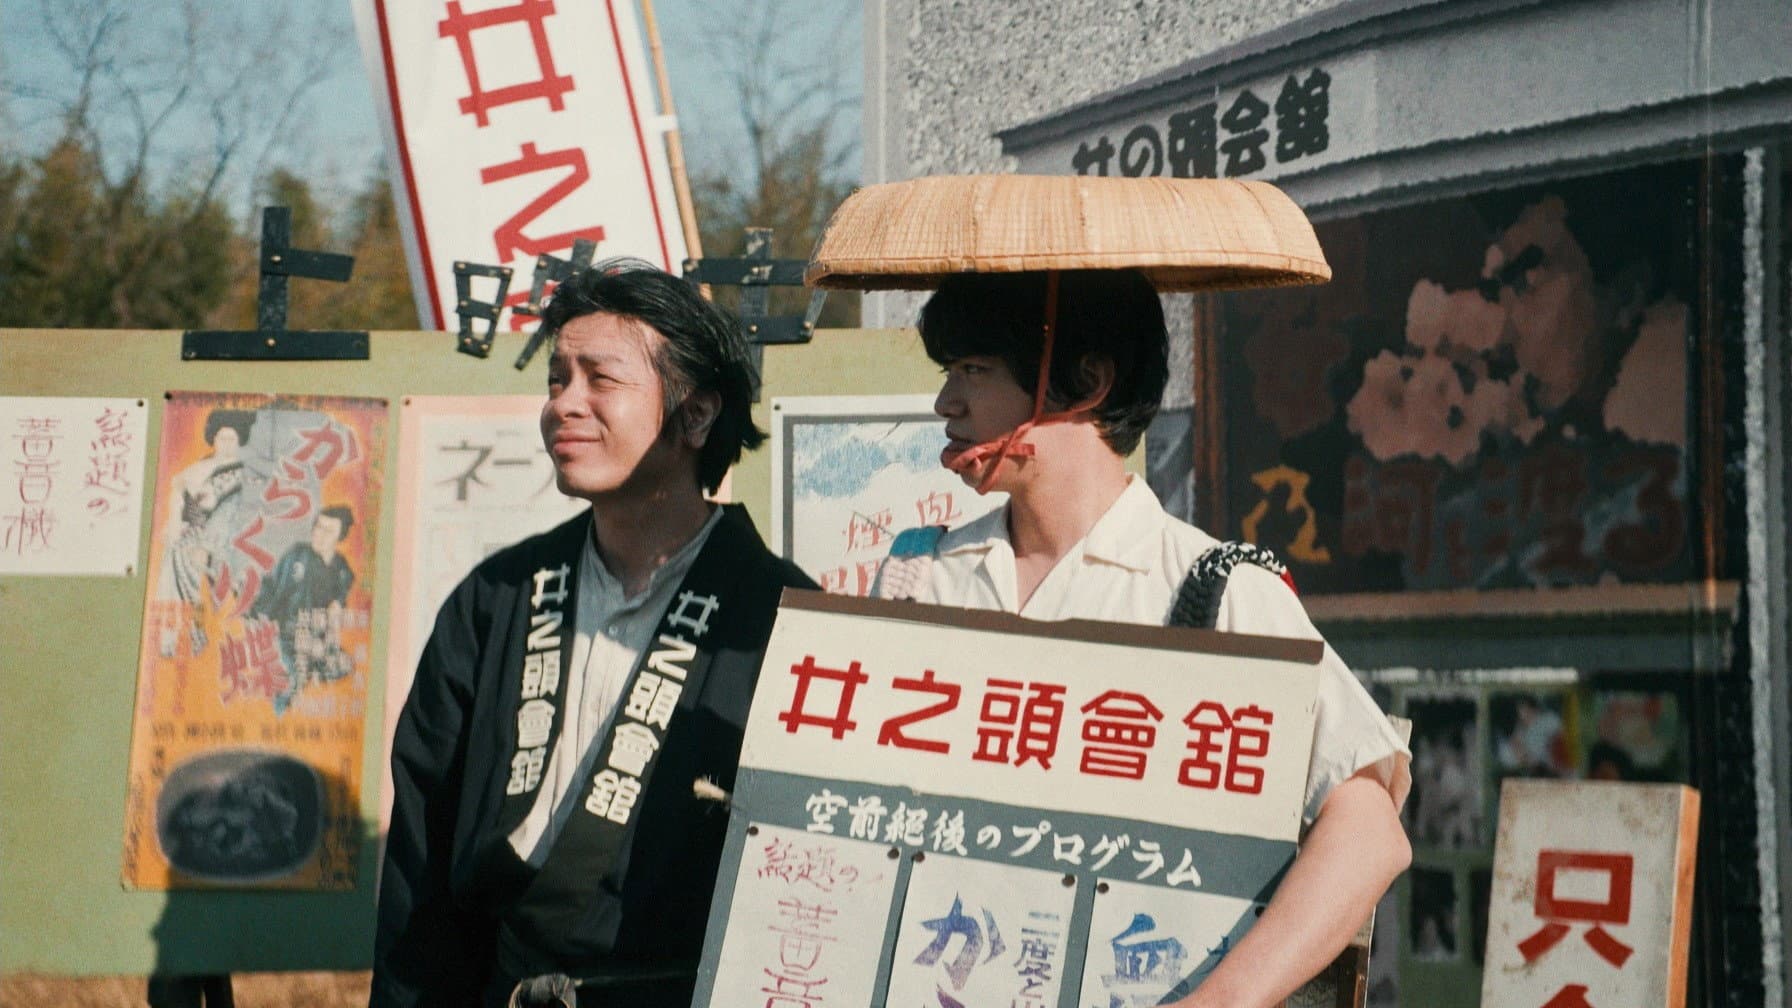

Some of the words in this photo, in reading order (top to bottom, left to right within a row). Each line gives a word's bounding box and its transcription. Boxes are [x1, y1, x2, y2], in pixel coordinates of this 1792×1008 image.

[438, 0, 606, 330] 井之
[433, 439, 556, 501] ネー
[912, 890, 1006, 1008] か
[1013, 911, 1060, 1008] 二度と
[1517, 848, 1634, 1008] 只
